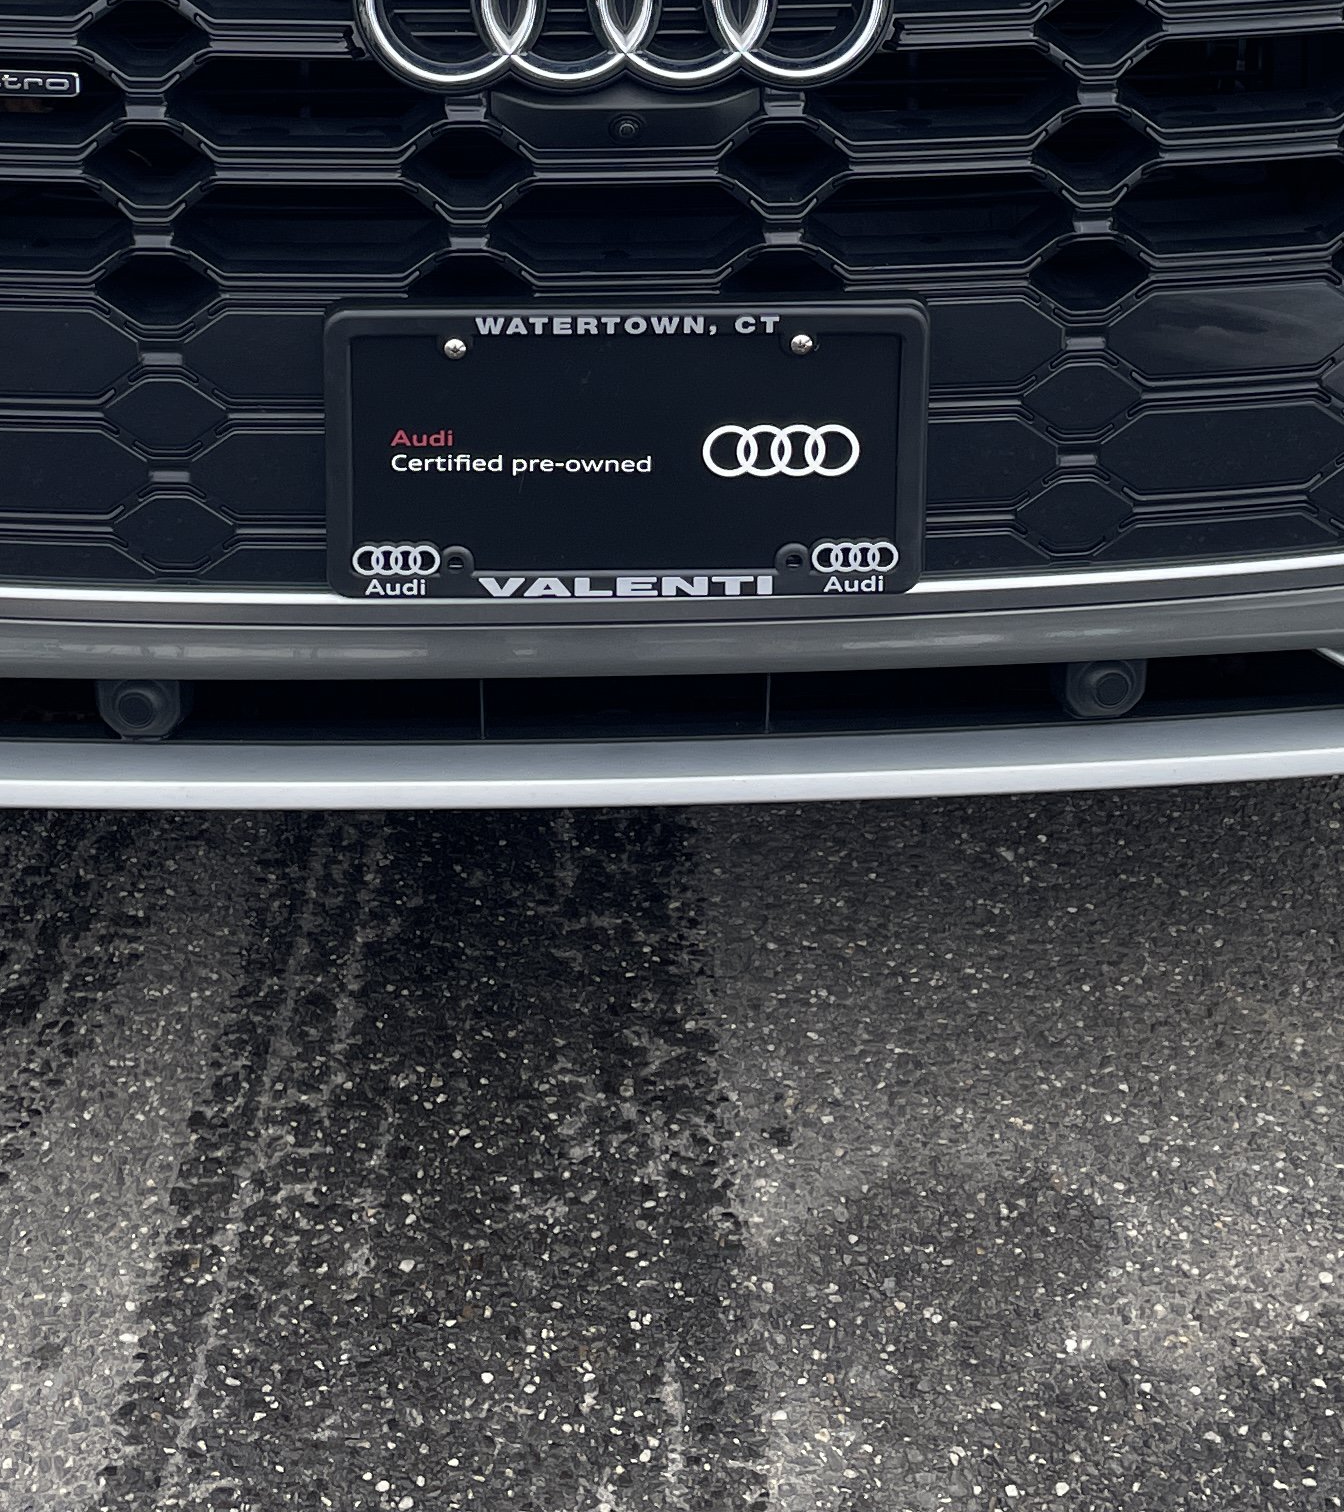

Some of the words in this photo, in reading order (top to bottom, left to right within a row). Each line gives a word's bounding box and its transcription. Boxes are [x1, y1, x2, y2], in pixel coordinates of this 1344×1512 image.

[475, 316, 717, 335] WATERTOWN,
[734, 316, 781, 334] CT
[390, 429, 454, 447] Audi
[391, 454, 503, 472] Certified
[512, 455, 652, 476] pre-owned
[365, 577, 427, 597] Audi
[477, 576, 774, 597] VALENTI
[823, 575, 885, 593] Audi
